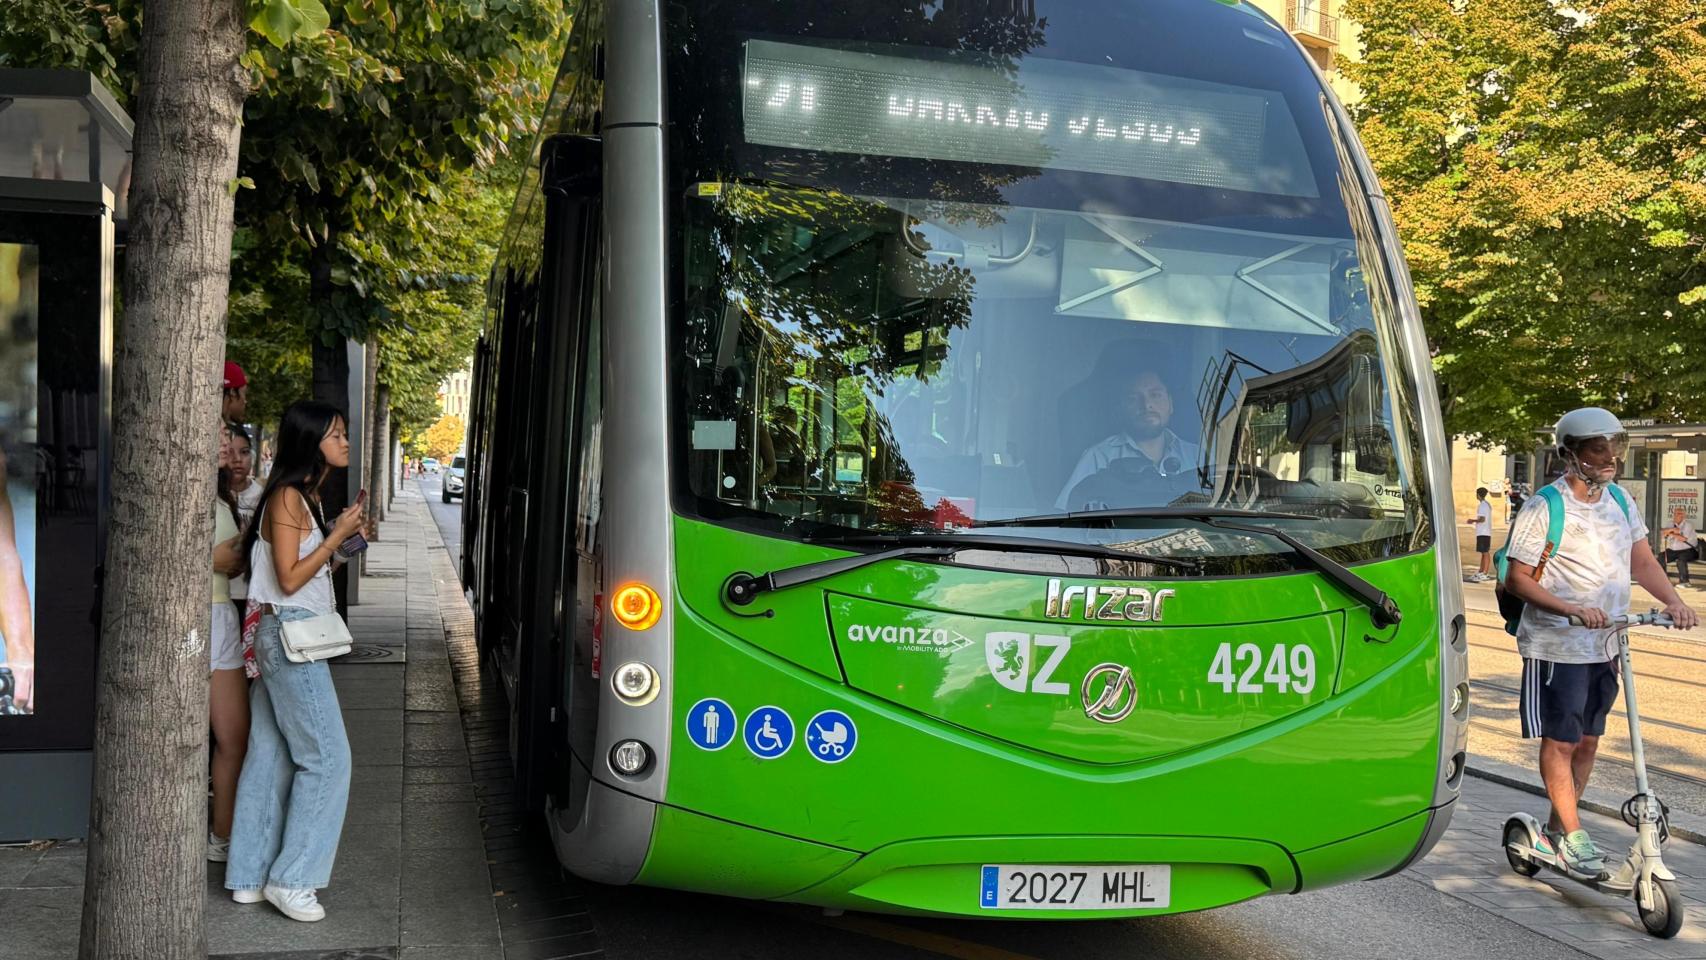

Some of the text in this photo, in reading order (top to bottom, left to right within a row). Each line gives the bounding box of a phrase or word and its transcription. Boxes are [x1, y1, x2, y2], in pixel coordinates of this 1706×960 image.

[1045, 578, 1176, 622] Irizar
[847, 623, 949, 646] avanza
[902, 645, 934, 653] MOBILITY
[1207, 642, 1316, 695] 4249
[986, 891, 993, 900] E
[1008, 871, 1155, 904] 2027 MHL
